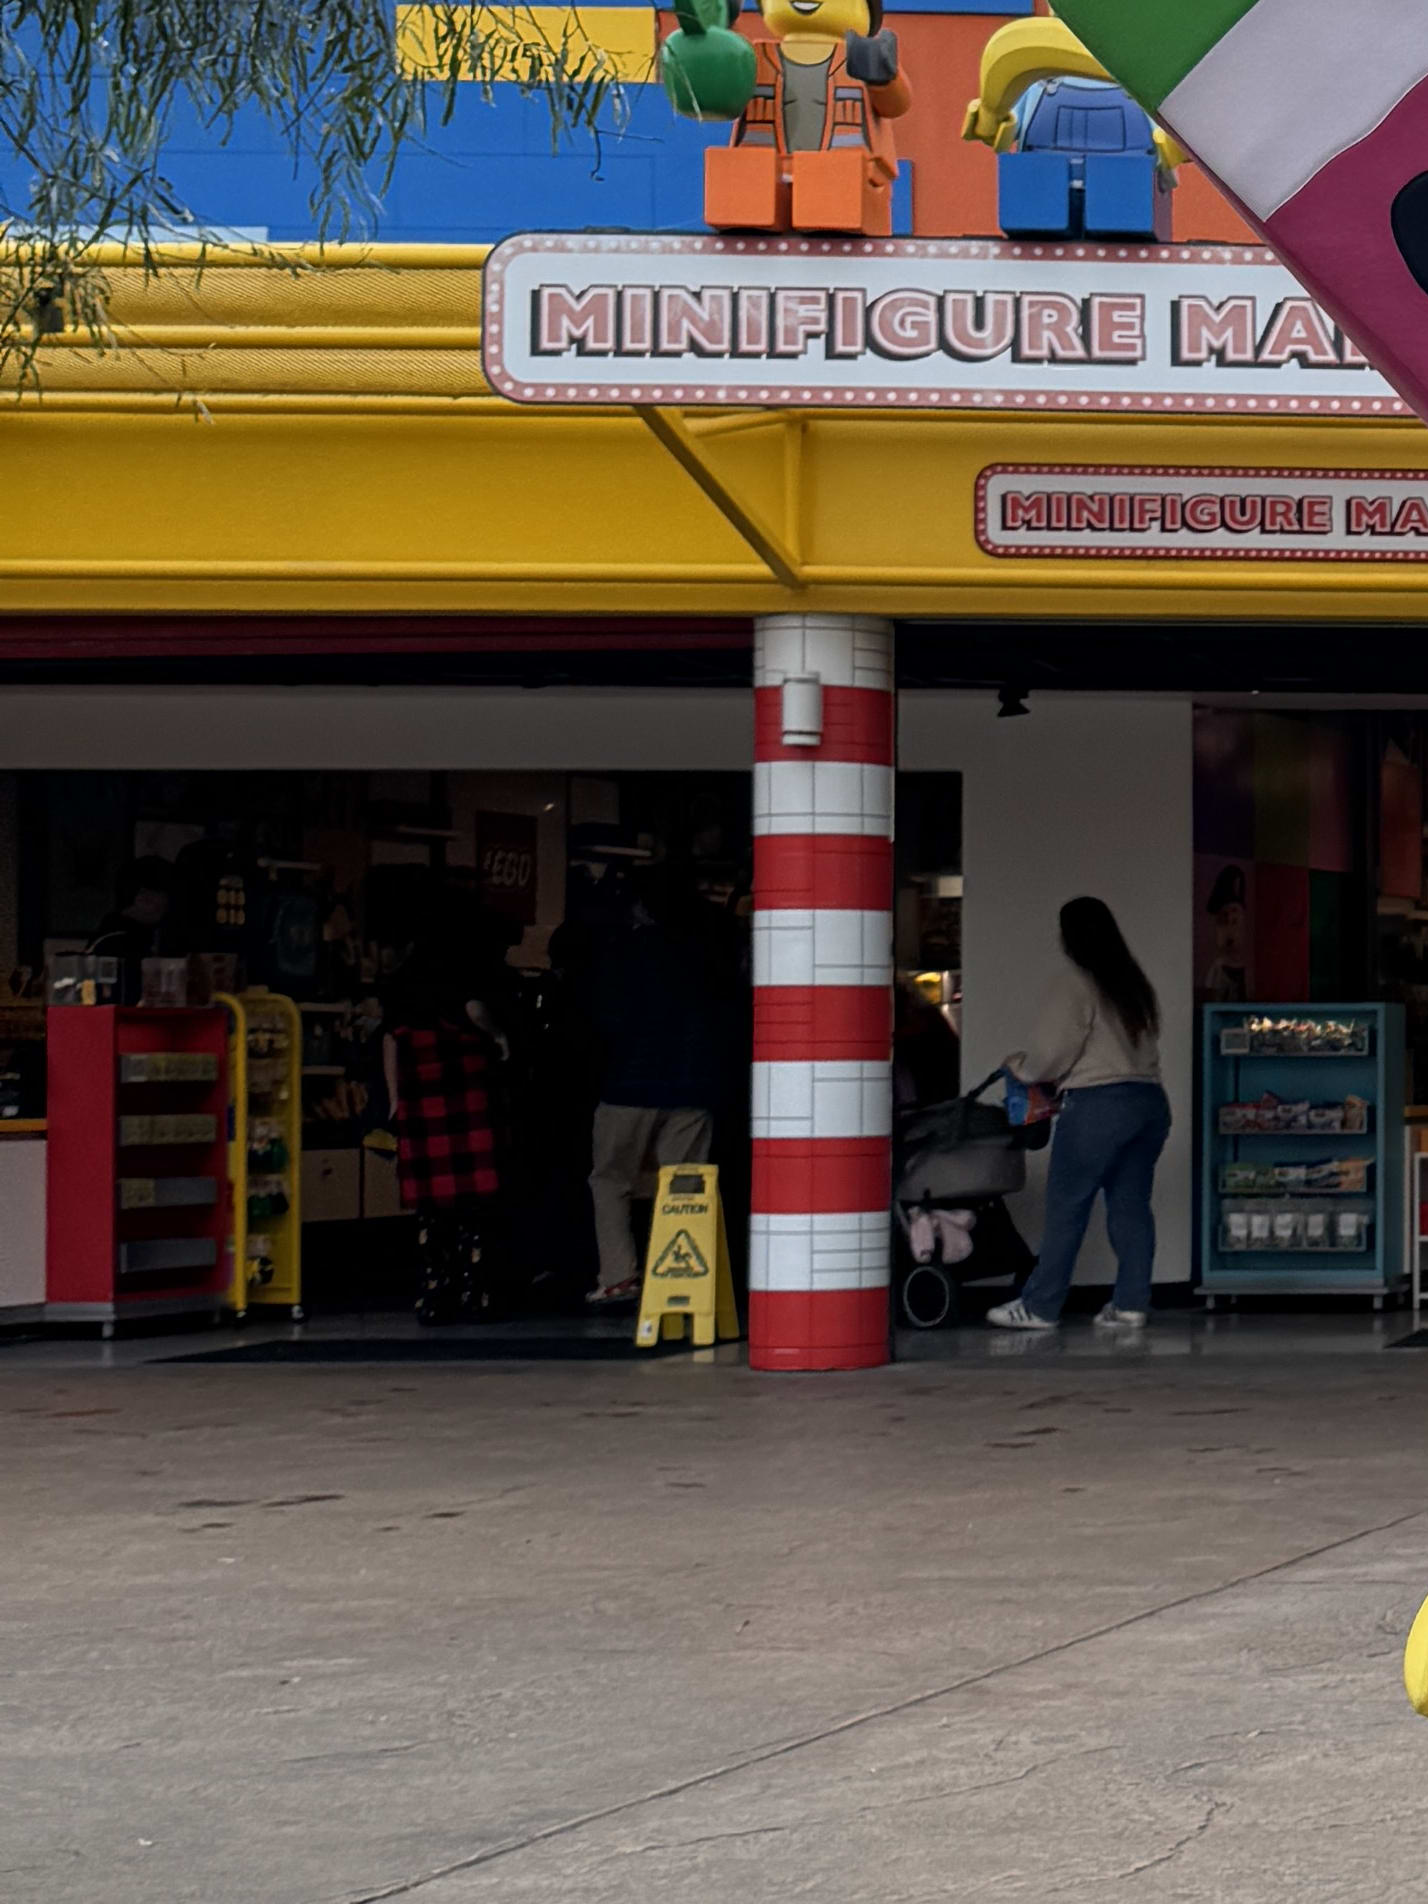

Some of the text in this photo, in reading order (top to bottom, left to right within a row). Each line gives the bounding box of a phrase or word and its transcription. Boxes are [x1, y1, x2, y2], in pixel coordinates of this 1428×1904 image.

[531, 284, 1378, 370] MINIFIGURE MA
[1001, 490, 1333, 535] MINIFIGURE
[661, 1203, 709, 1215] CAUTION
